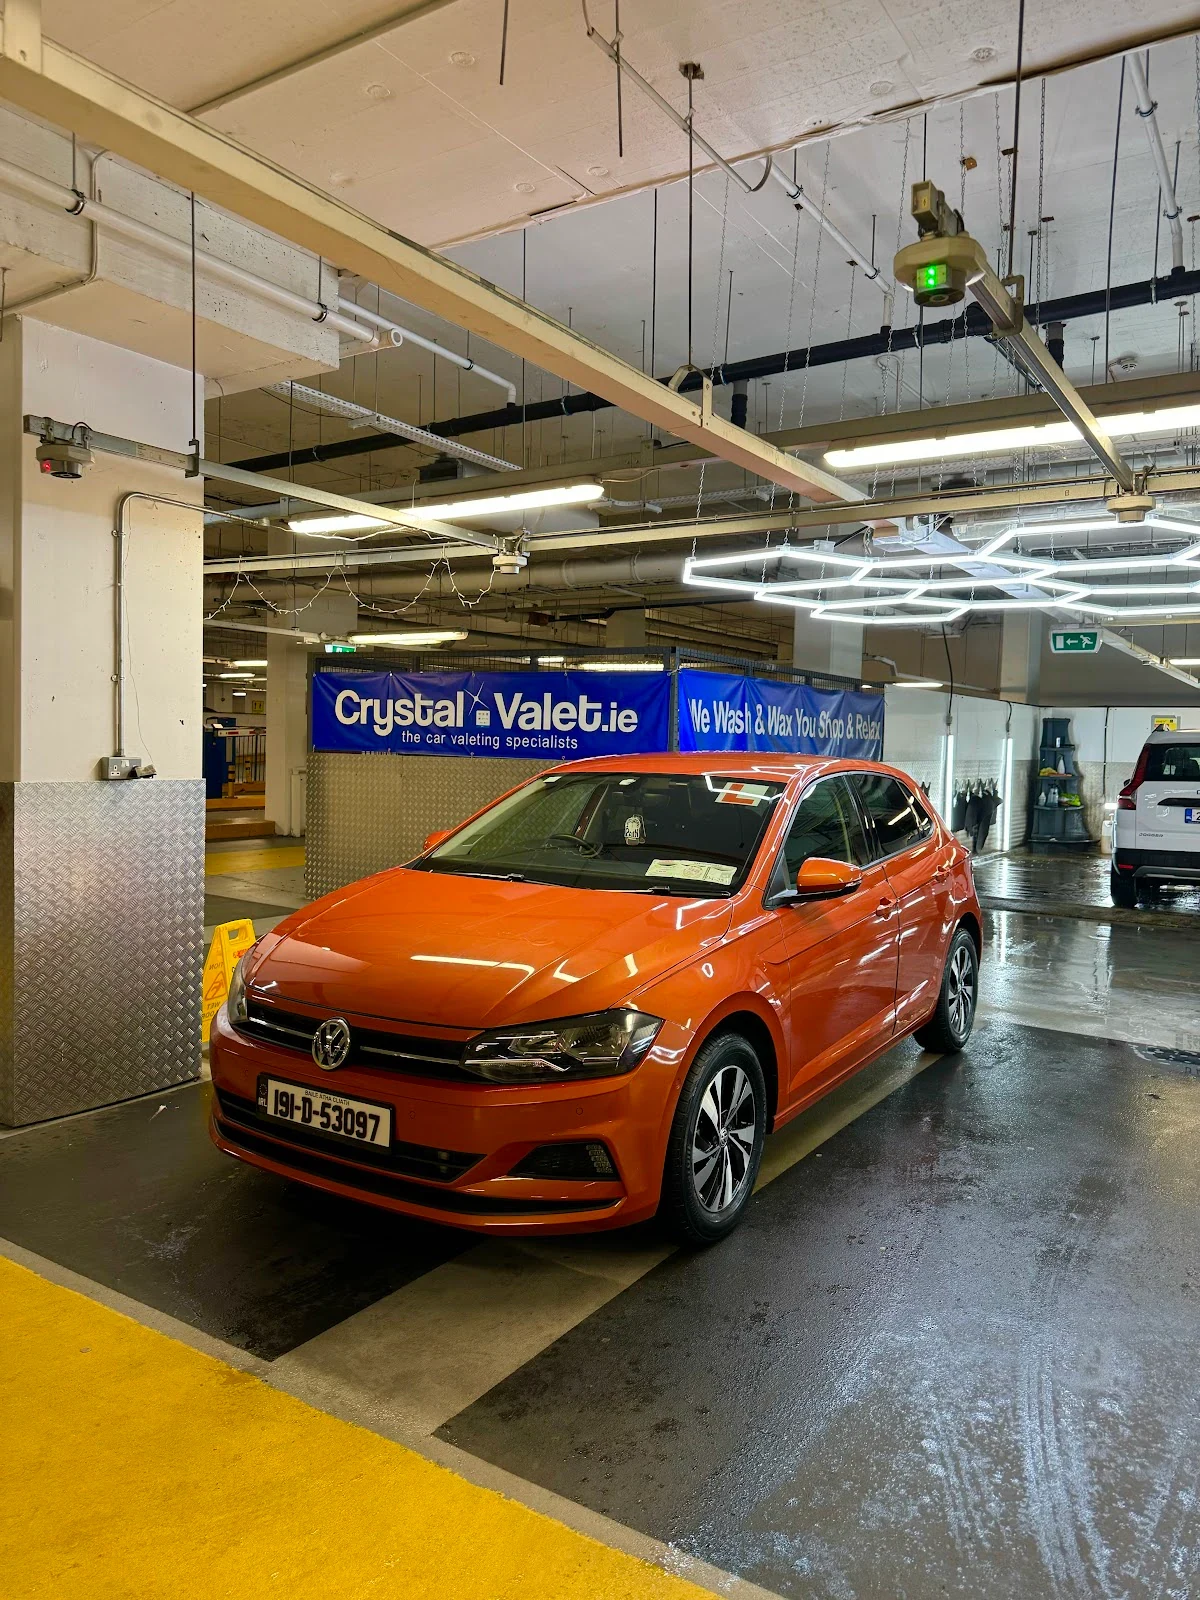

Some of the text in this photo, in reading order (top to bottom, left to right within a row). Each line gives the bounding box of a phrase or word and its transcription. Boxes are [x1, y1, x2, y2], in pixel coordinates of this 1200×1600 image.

[335, 689, 639, 737] Crystal Valet.ie
[688, 698, 881, 746] We Wash & Wax You Shop & Relax
[401, 730, 578, 750] the car valeting specialists
[721, 783, 755, 805] L
[258, 1096, 268, 1107] IRL
[304, 1089, 319, 1099] BAILE
[332, 1096, 350, 1106] CLIATH
[273, 1088, 381, 1142] 191-D-53097
